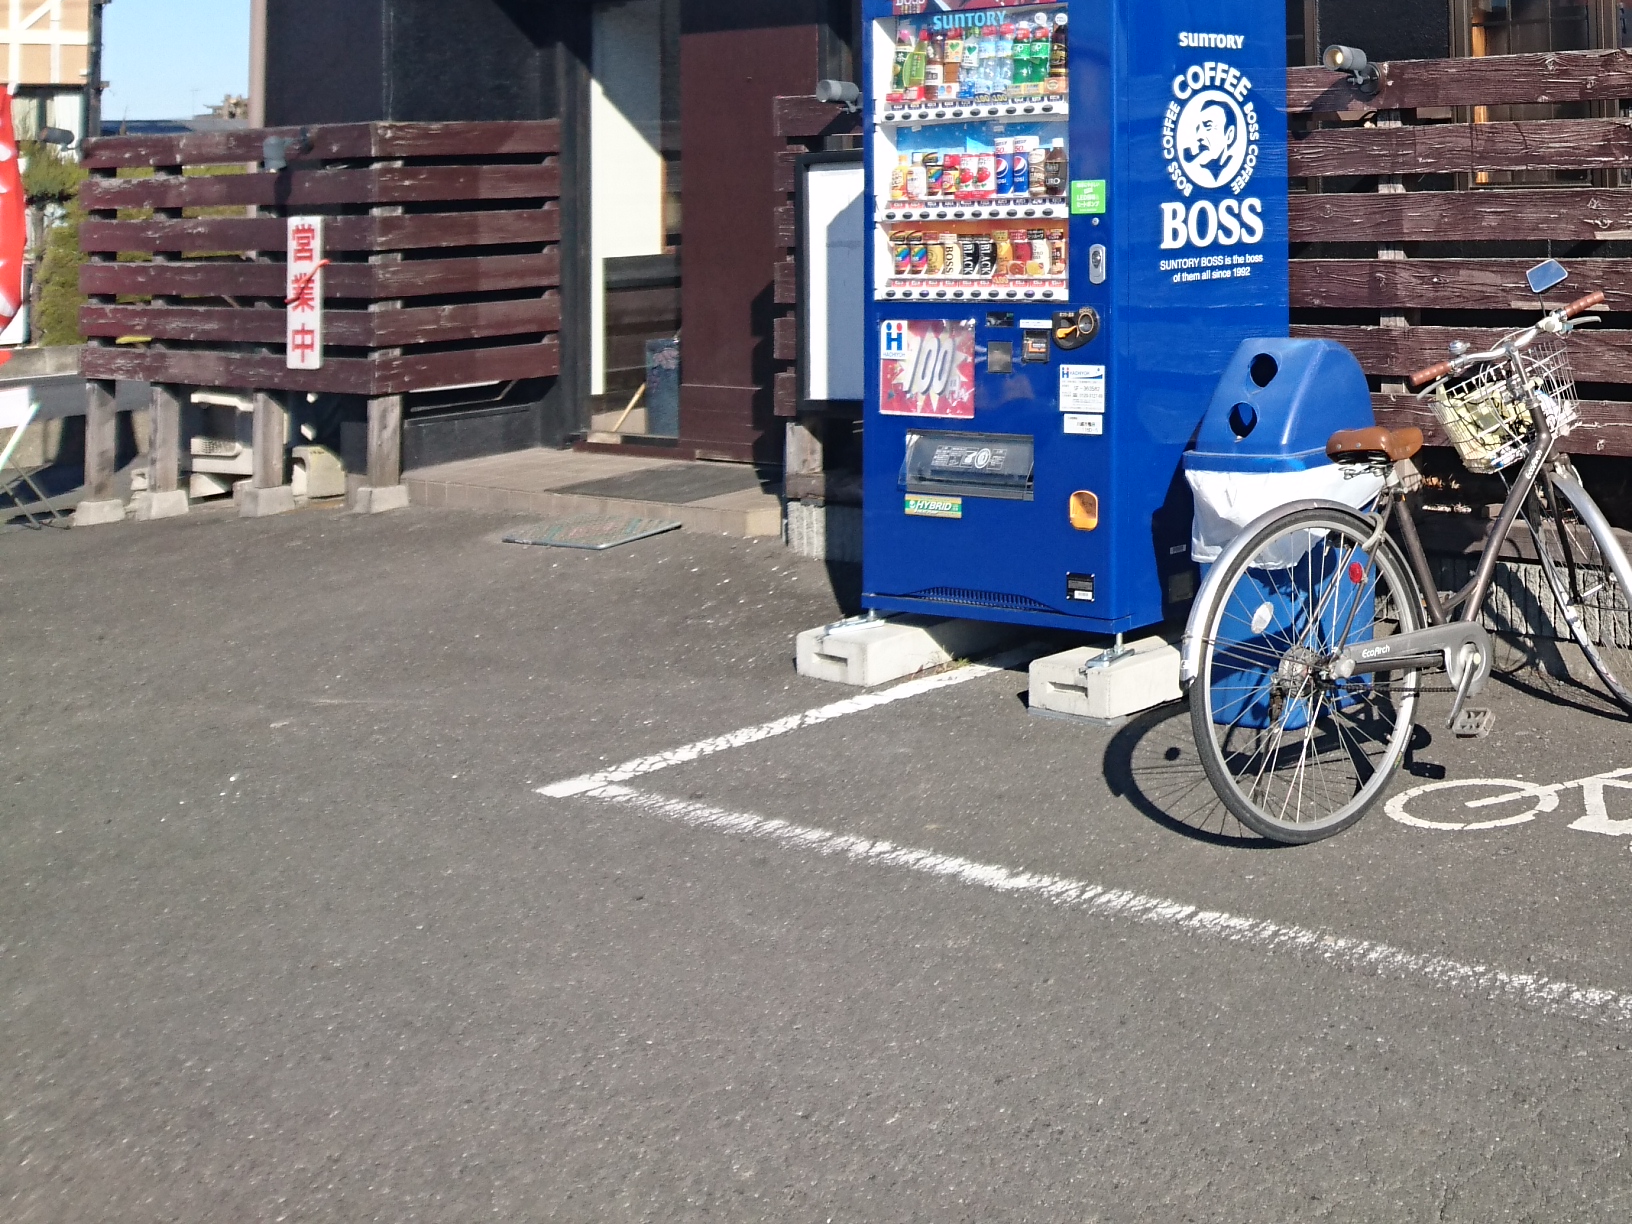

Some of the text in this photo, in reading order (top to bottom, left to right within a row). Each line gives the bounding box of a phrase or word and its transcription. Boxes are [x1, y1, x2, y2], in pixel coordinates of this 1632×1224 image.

[933, 10, 1006, 31] SUNTORY
[1178, 32, 1245, 49] SUNTORY
[1173, 61, 1252, 103] COFFEE
[1162, 100, 1193, 197] BOSS COFFEE
[1230, 101, 1260, 196] BOSS COFFEE
[1160, 197, 1264, 250] BOSS
[945, 245, 954, 274] BOSS
[1160, 253, 1263, 271] SUNTORY BOSS is the boss
[1173, 267, 1251, 282] of them all since 1992
[292, 224, 315, 363] 営業中
[914, 500, 952, 512] HYBRID
[1362, 644, 1390, 658] EcoArch
